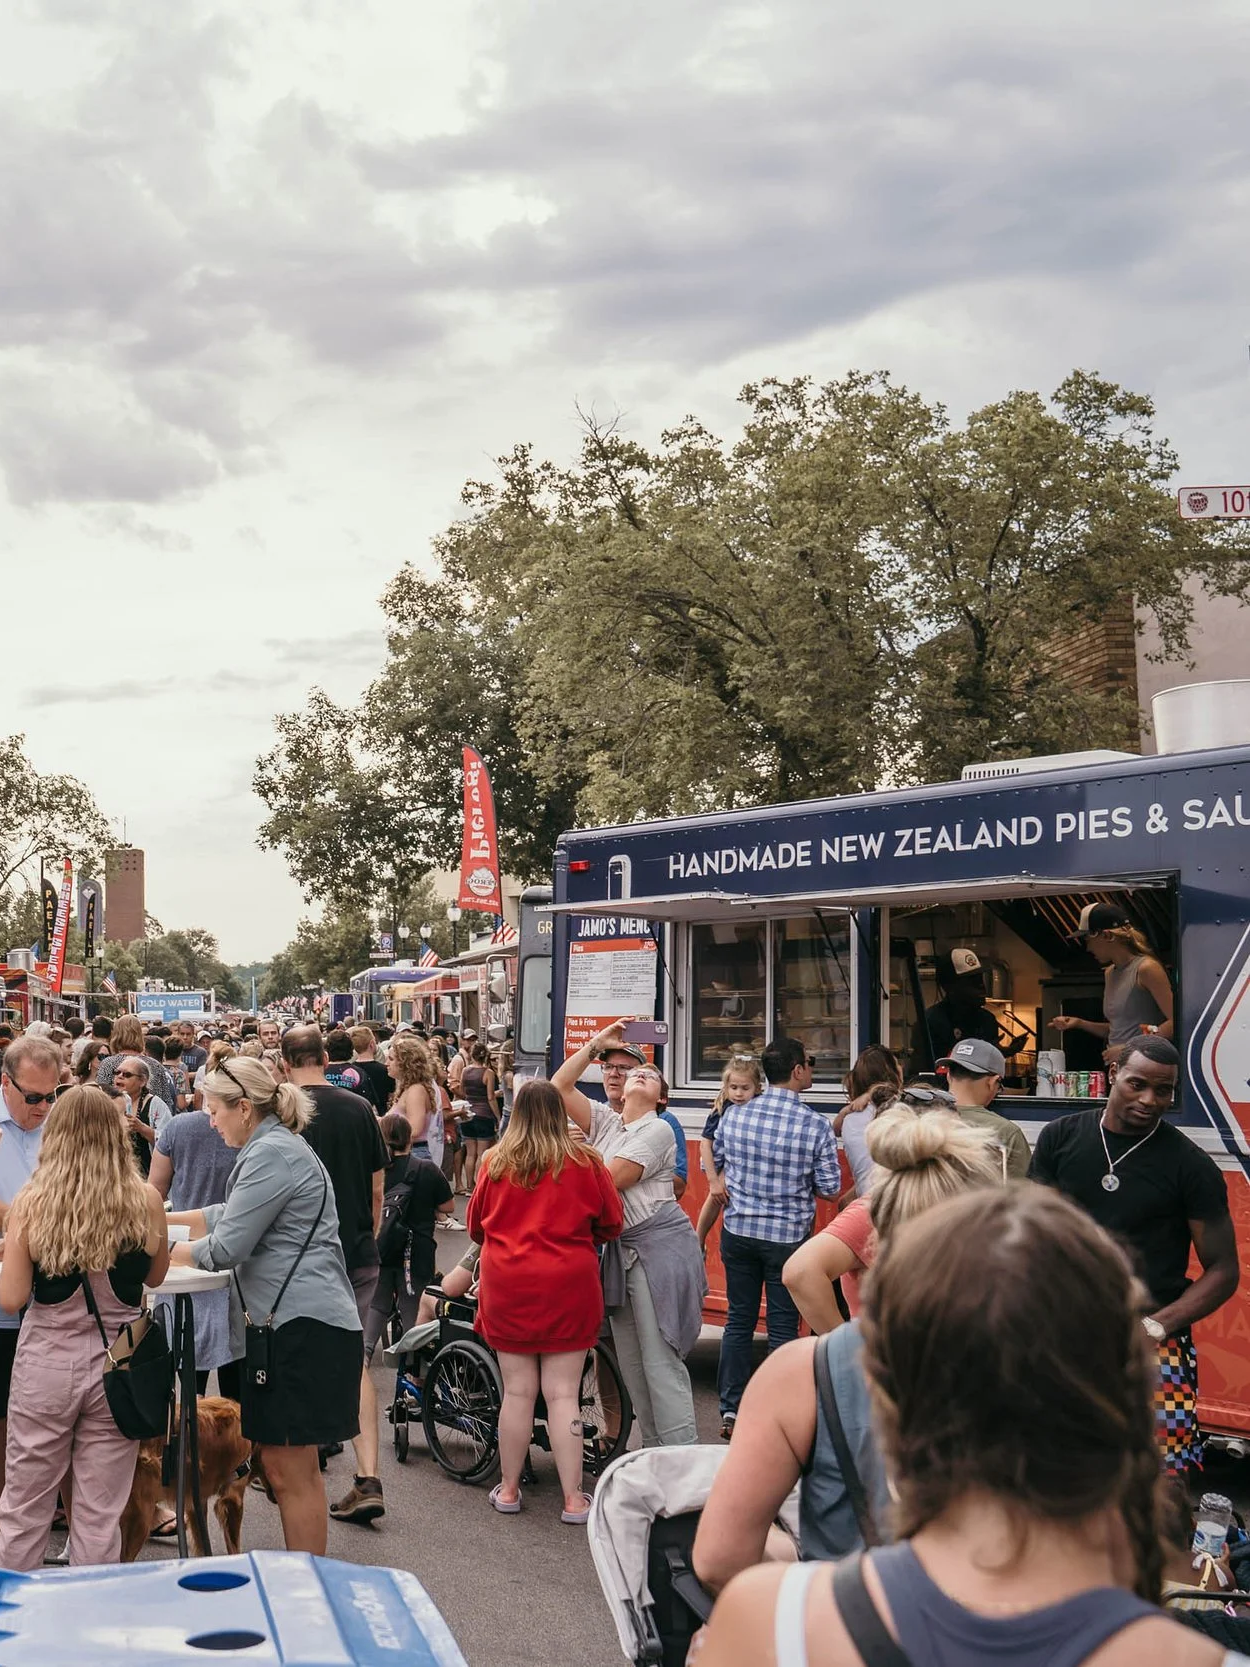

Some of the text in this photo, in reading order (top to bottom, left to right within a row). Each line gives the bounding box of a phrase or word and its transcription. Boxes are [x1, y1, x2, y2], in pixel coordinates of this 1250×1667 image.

[1222, 491, 1250, 513] 10
[668, 795, 1250, 879] HANDMADE NEW ZEALAND PIES & SAU
[578, 917, 616, 937] JAMO'S
[140, 999, 200, 1008] COLD WATER
[584, 1018, 597, 1027] Fries
[568, 1029, 589, 1039] Sausage
